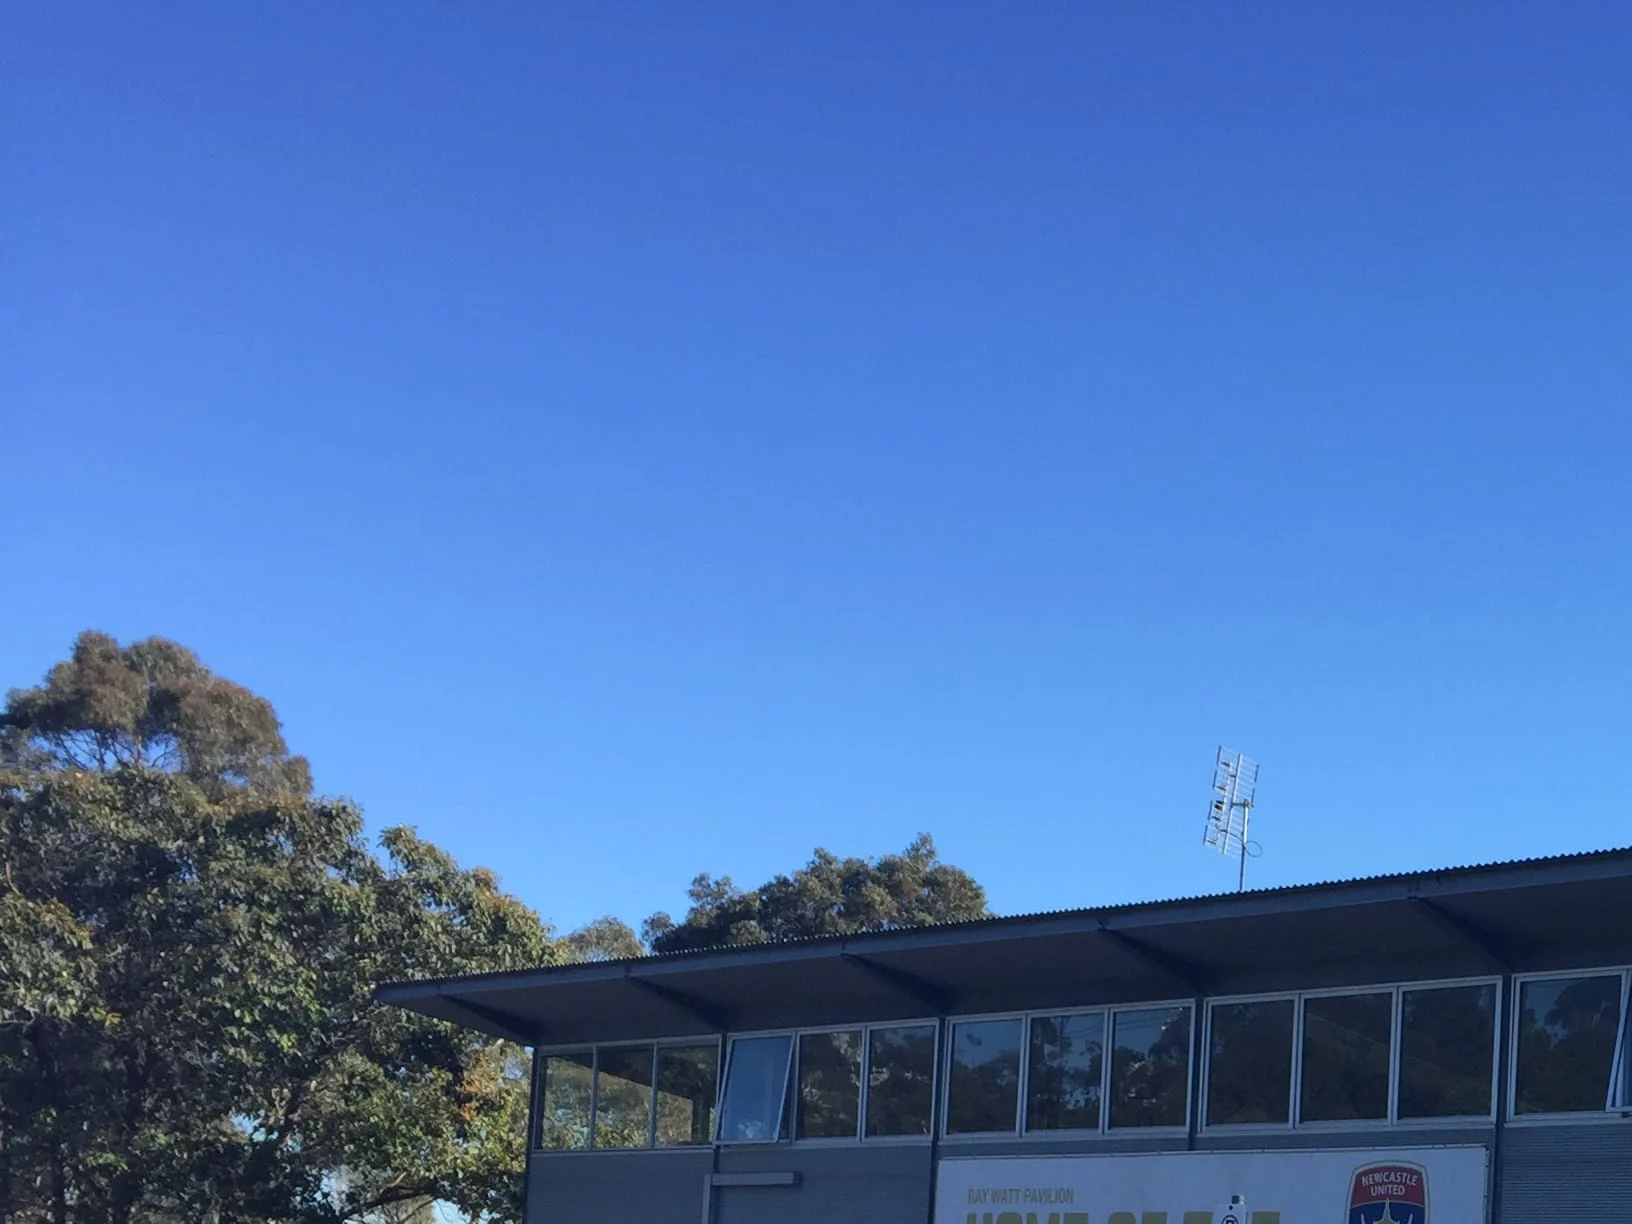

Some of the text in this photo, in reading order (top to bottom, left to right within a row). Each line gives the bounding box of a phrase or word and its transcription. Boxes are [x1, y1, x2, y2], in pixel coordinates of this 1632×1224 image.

[1361, 1171, 1418, 1187] NEWCASTLE
[1024, 1187, 1074, 1204] PAVILION
[1370, 1184, 1406, 1196] UNITED
